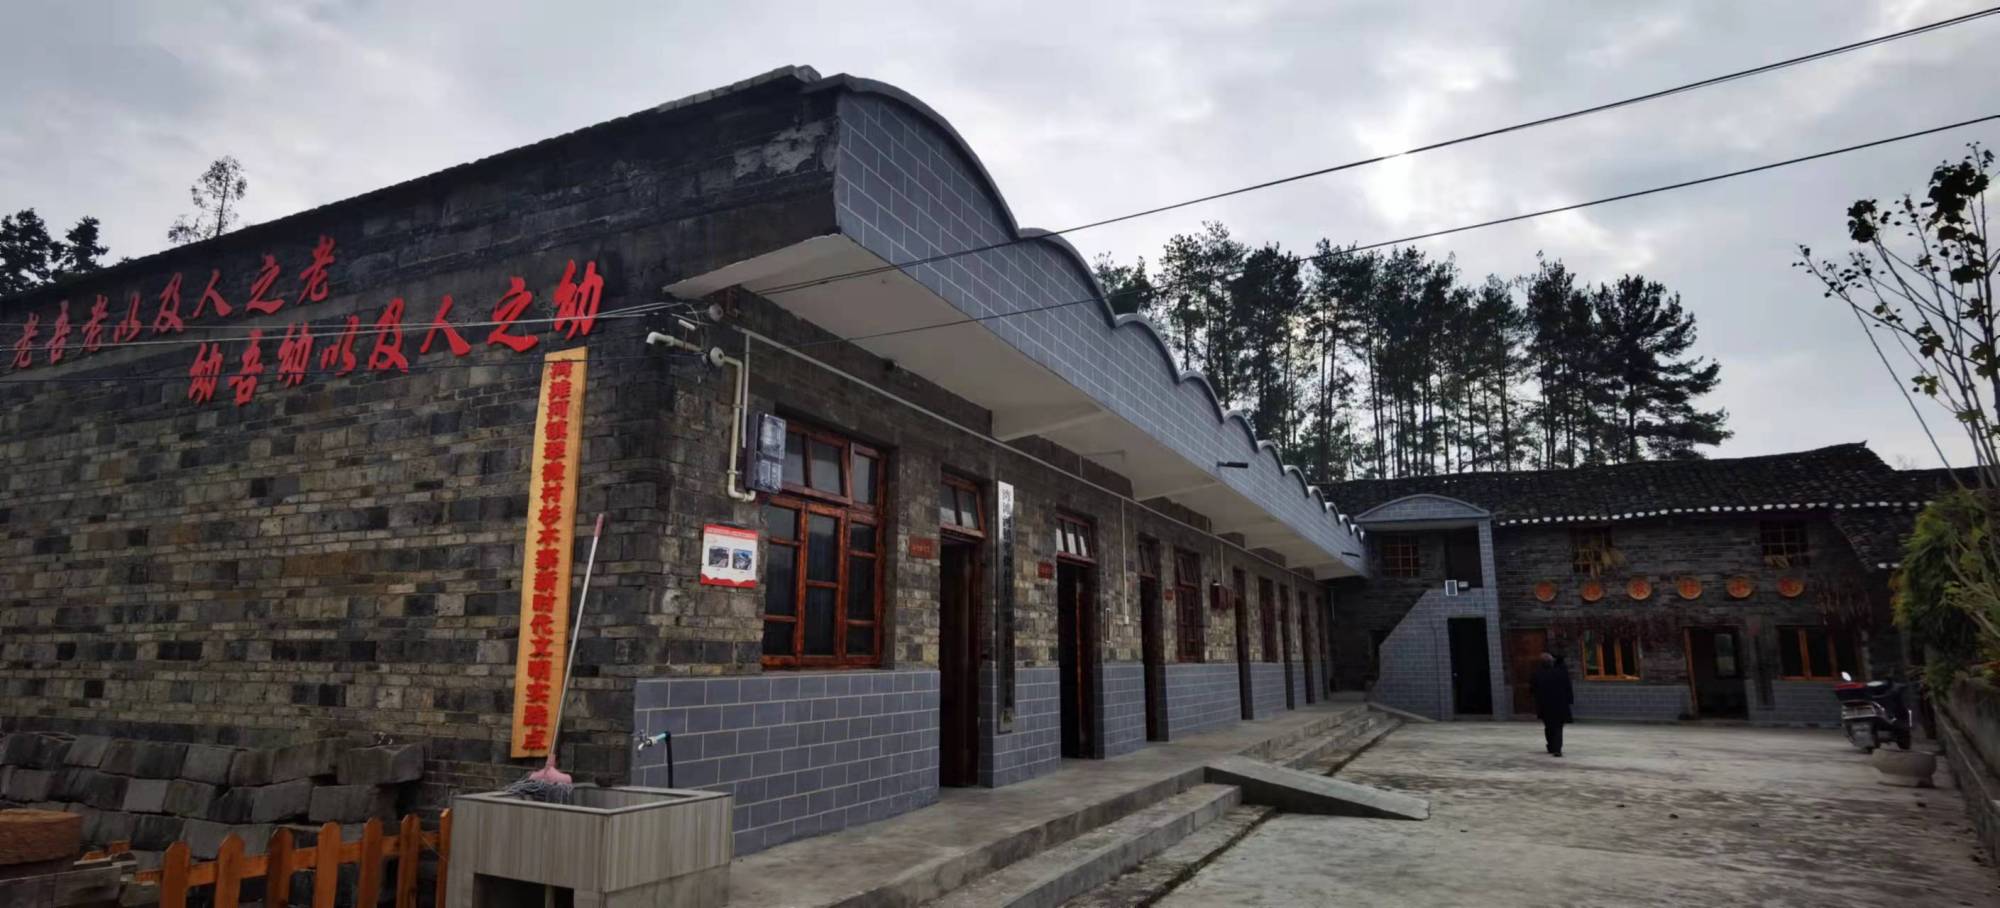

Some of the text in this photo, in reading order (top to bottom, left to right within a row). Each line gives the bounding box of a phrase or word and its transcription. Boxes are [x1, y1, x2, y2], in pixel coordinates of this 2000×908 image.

[10, 235, 335, 369] 老吾老以及人之老
[188, 259, 604, 405] 幼吾幼以及人之幼
